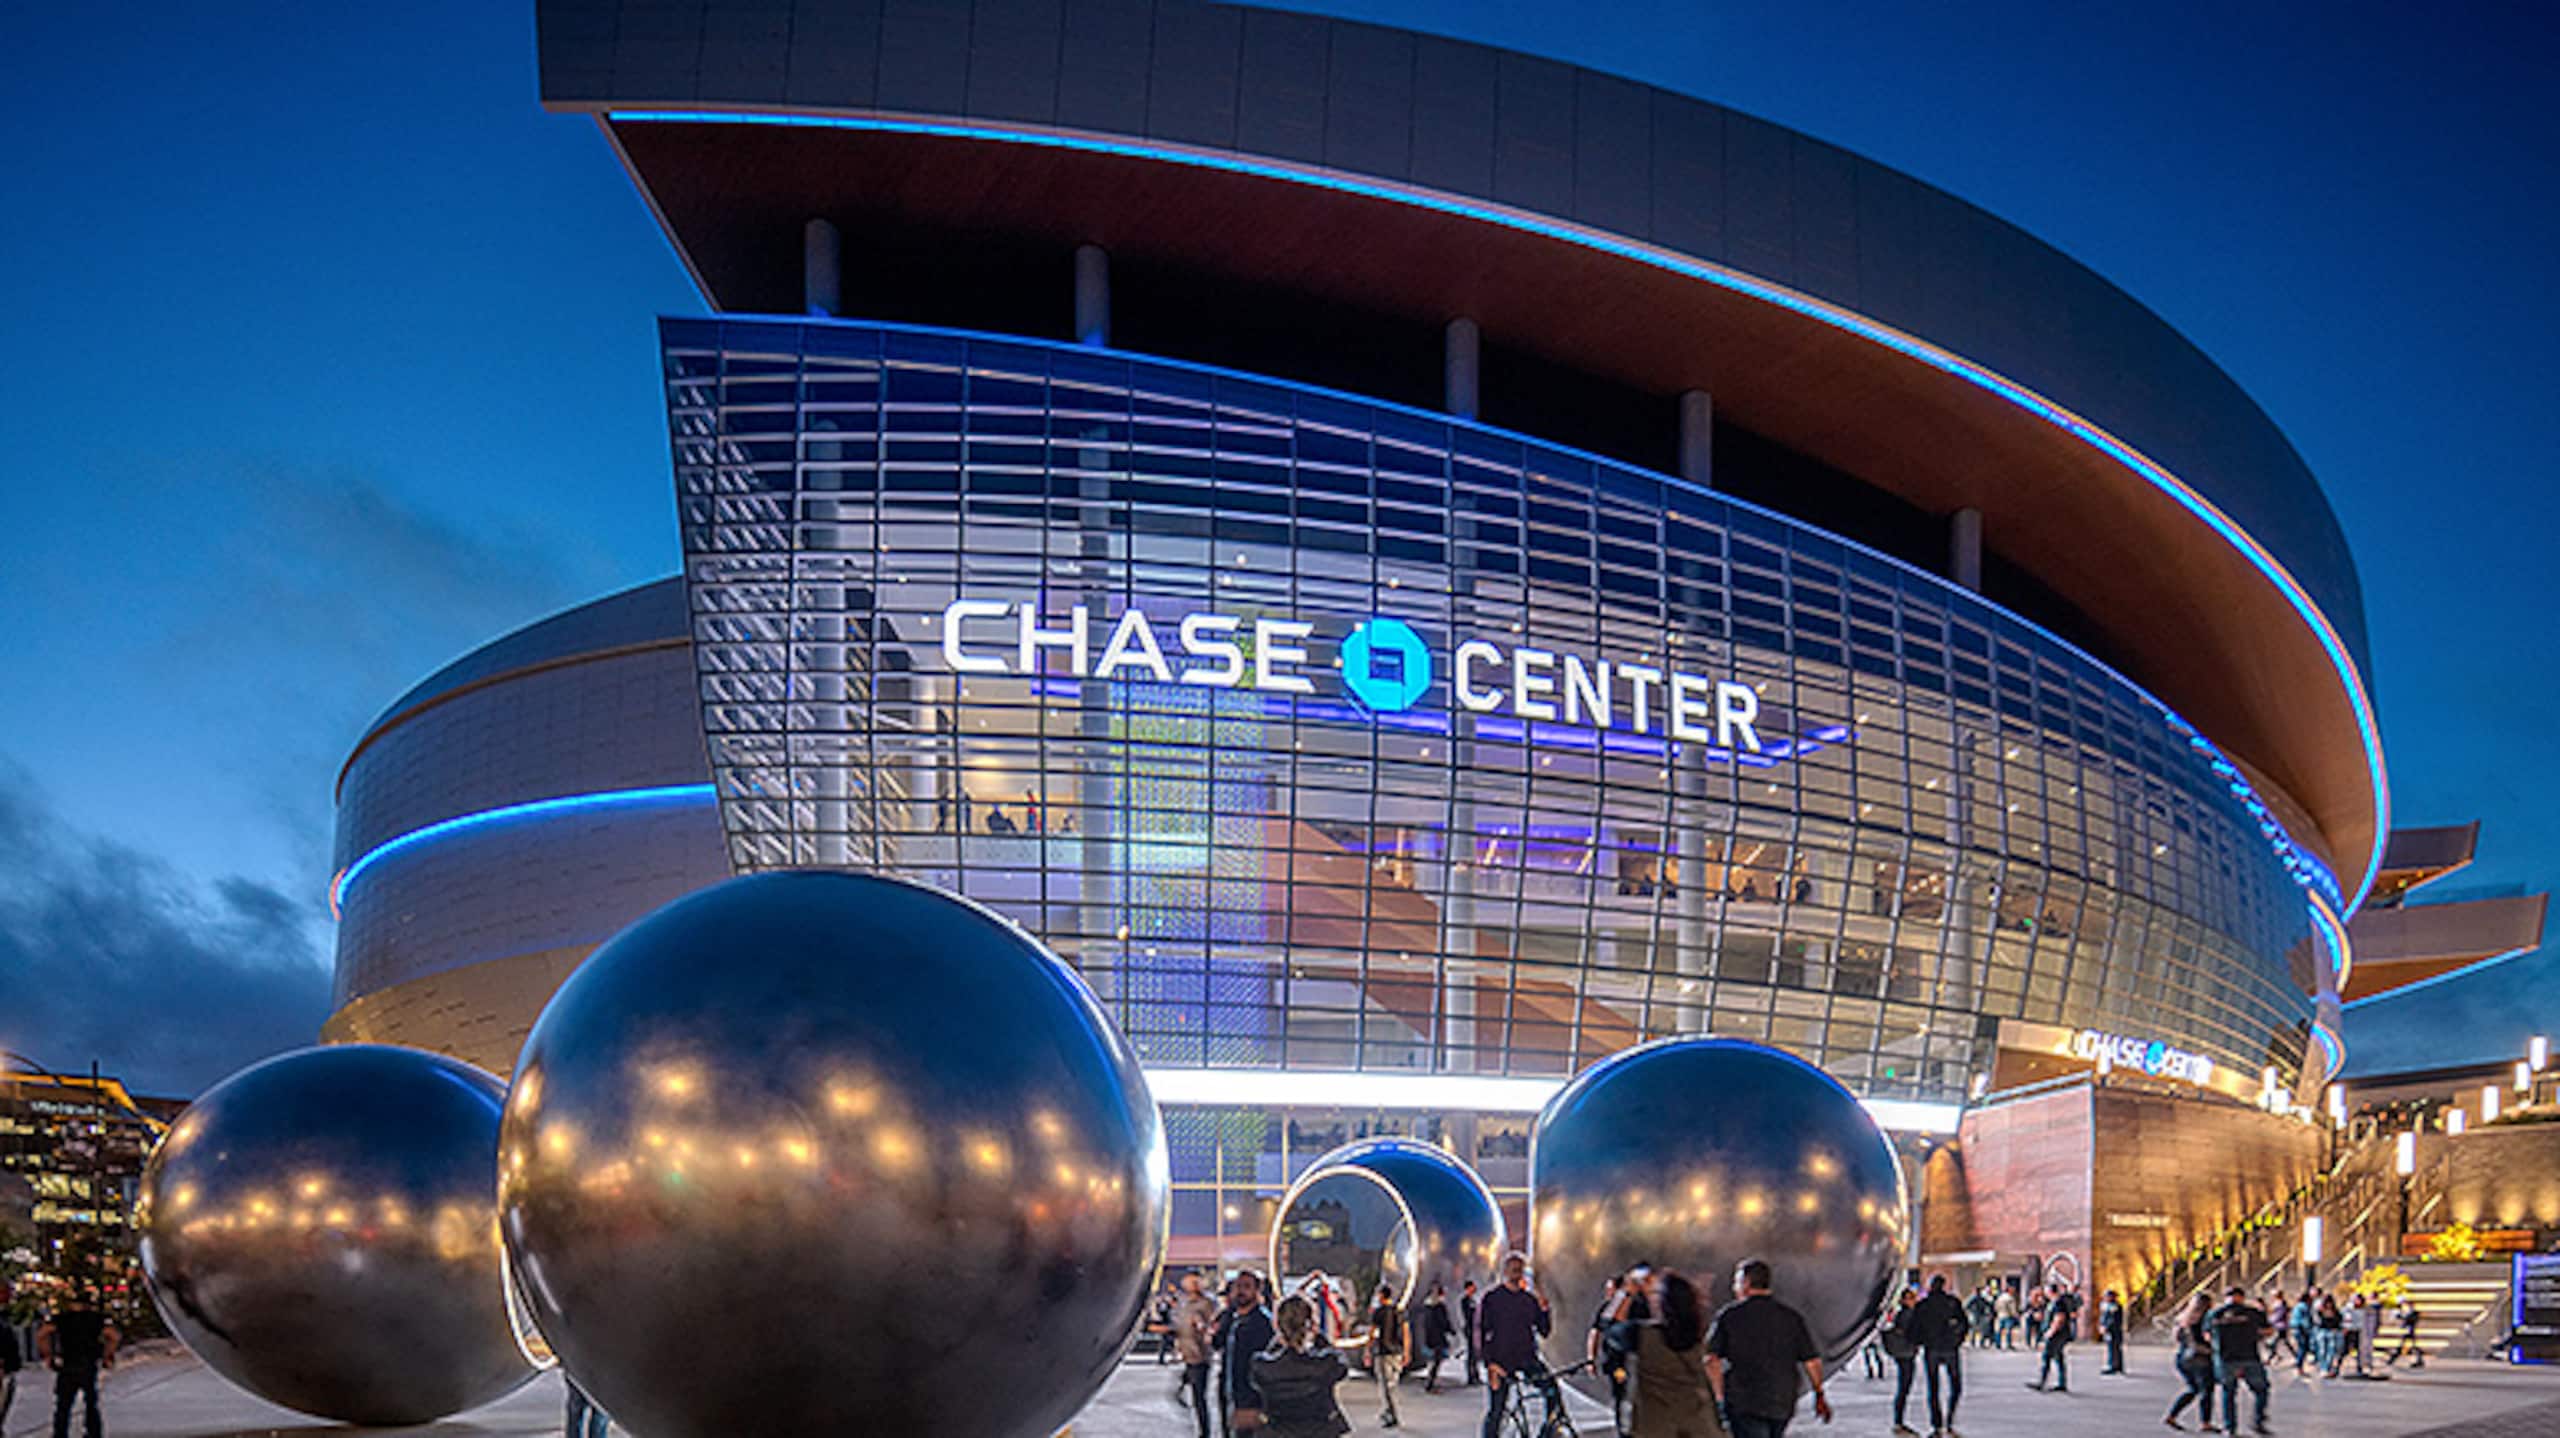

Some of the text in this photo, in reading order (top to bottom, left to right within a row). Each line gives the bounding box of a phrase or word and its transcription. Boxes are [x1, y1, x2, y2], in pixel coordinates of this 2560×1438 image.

[943, 600, 1761, 752] CHASE CENTER
[2164, 1047, 2213, 1083] CEN
